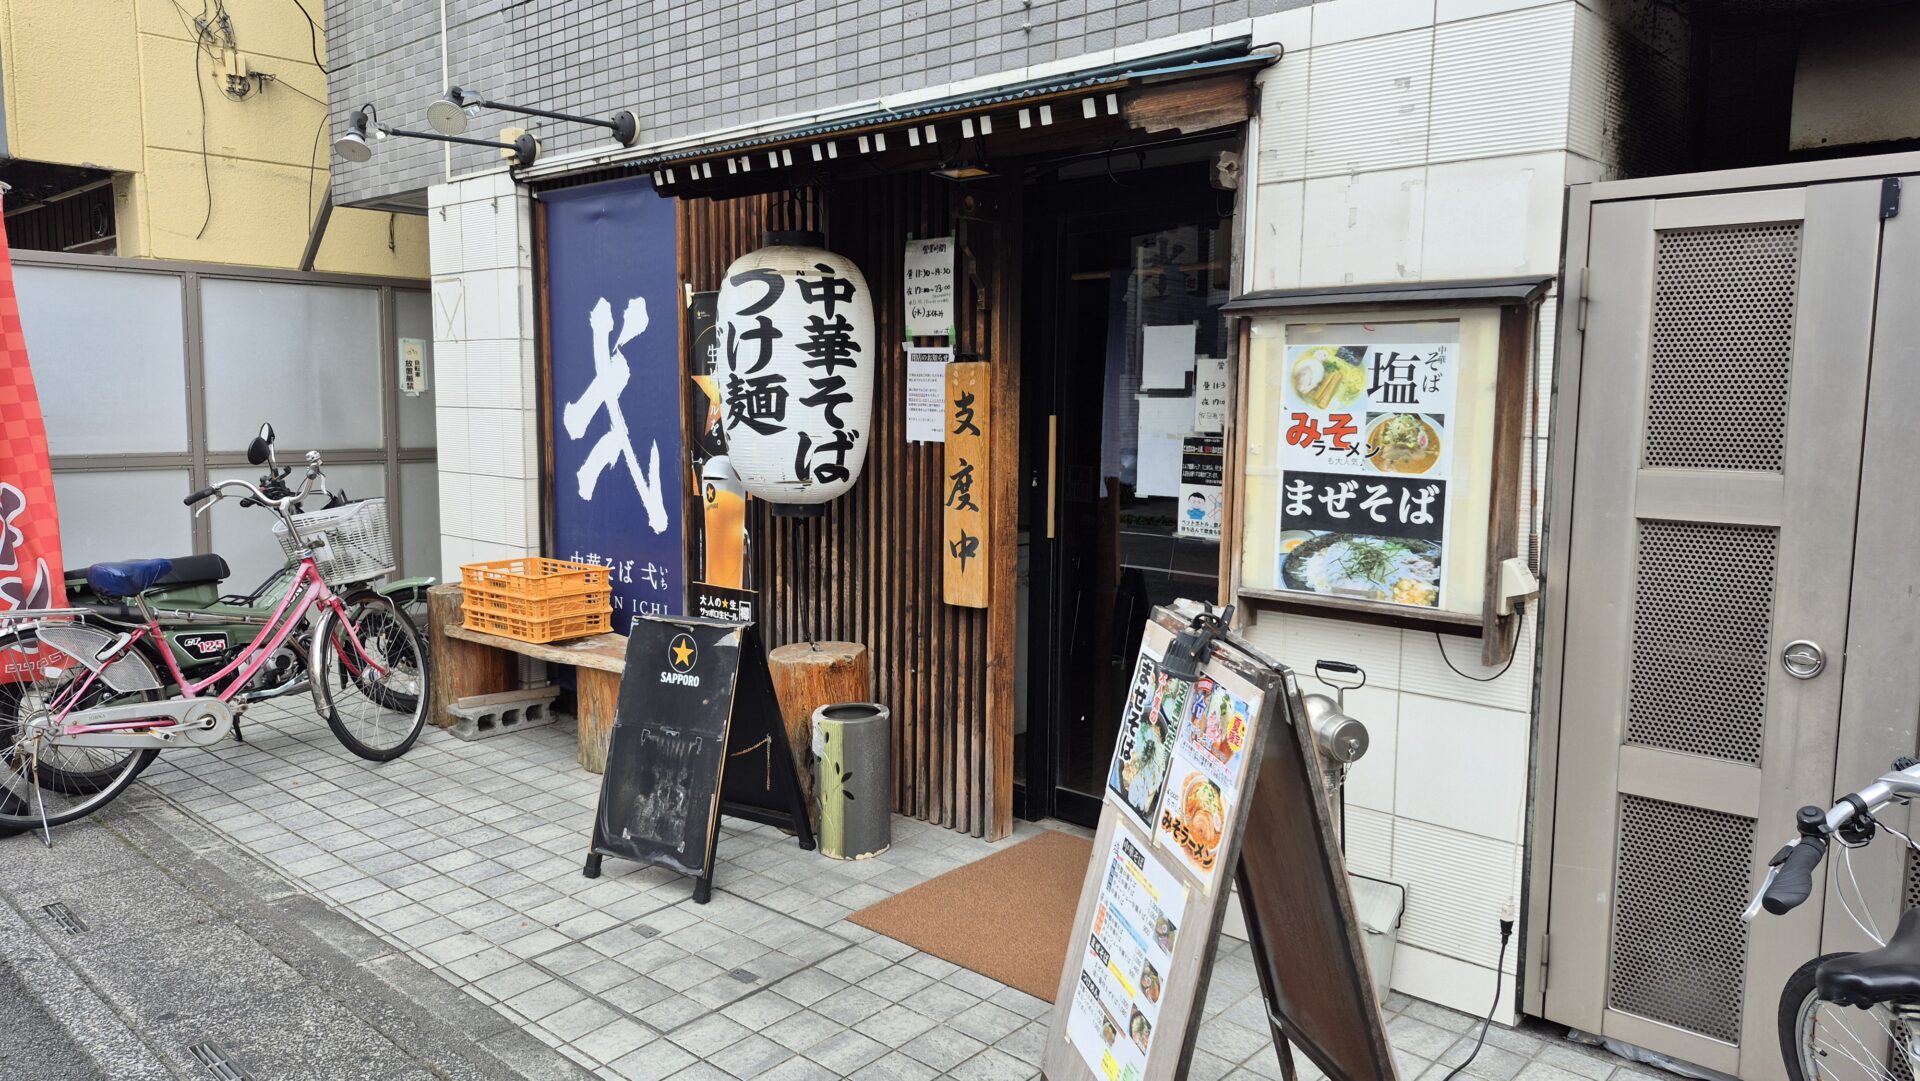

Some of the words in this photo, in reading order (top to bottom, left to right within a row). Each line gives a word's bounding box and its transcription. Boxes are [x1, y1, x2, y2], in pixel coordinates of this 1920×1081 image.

[726, 268, 789, 436] つけ麺
[795, 263, 862, 484] 中華そば
[1213, 382, 1226, 390] 11:3
[1366, 351, 1421, 404] 塩
[1422, 351, 1443, 393] そば
[1286, 412, 1358, 449] みそ
[1312, 441, 1380, 459] ラーメン
[944, 390, 981, 577] 支度中
[1285, 479, 1440, 525] まぜそば
[660, 566, 668, 590] いち
[632, 599, 668, 616] ICHI
[198, 639, 226, 654] 125
[660, 671, 700, 688] SAPPORO
[1162, 810, 1213, 866] みそラーメン
